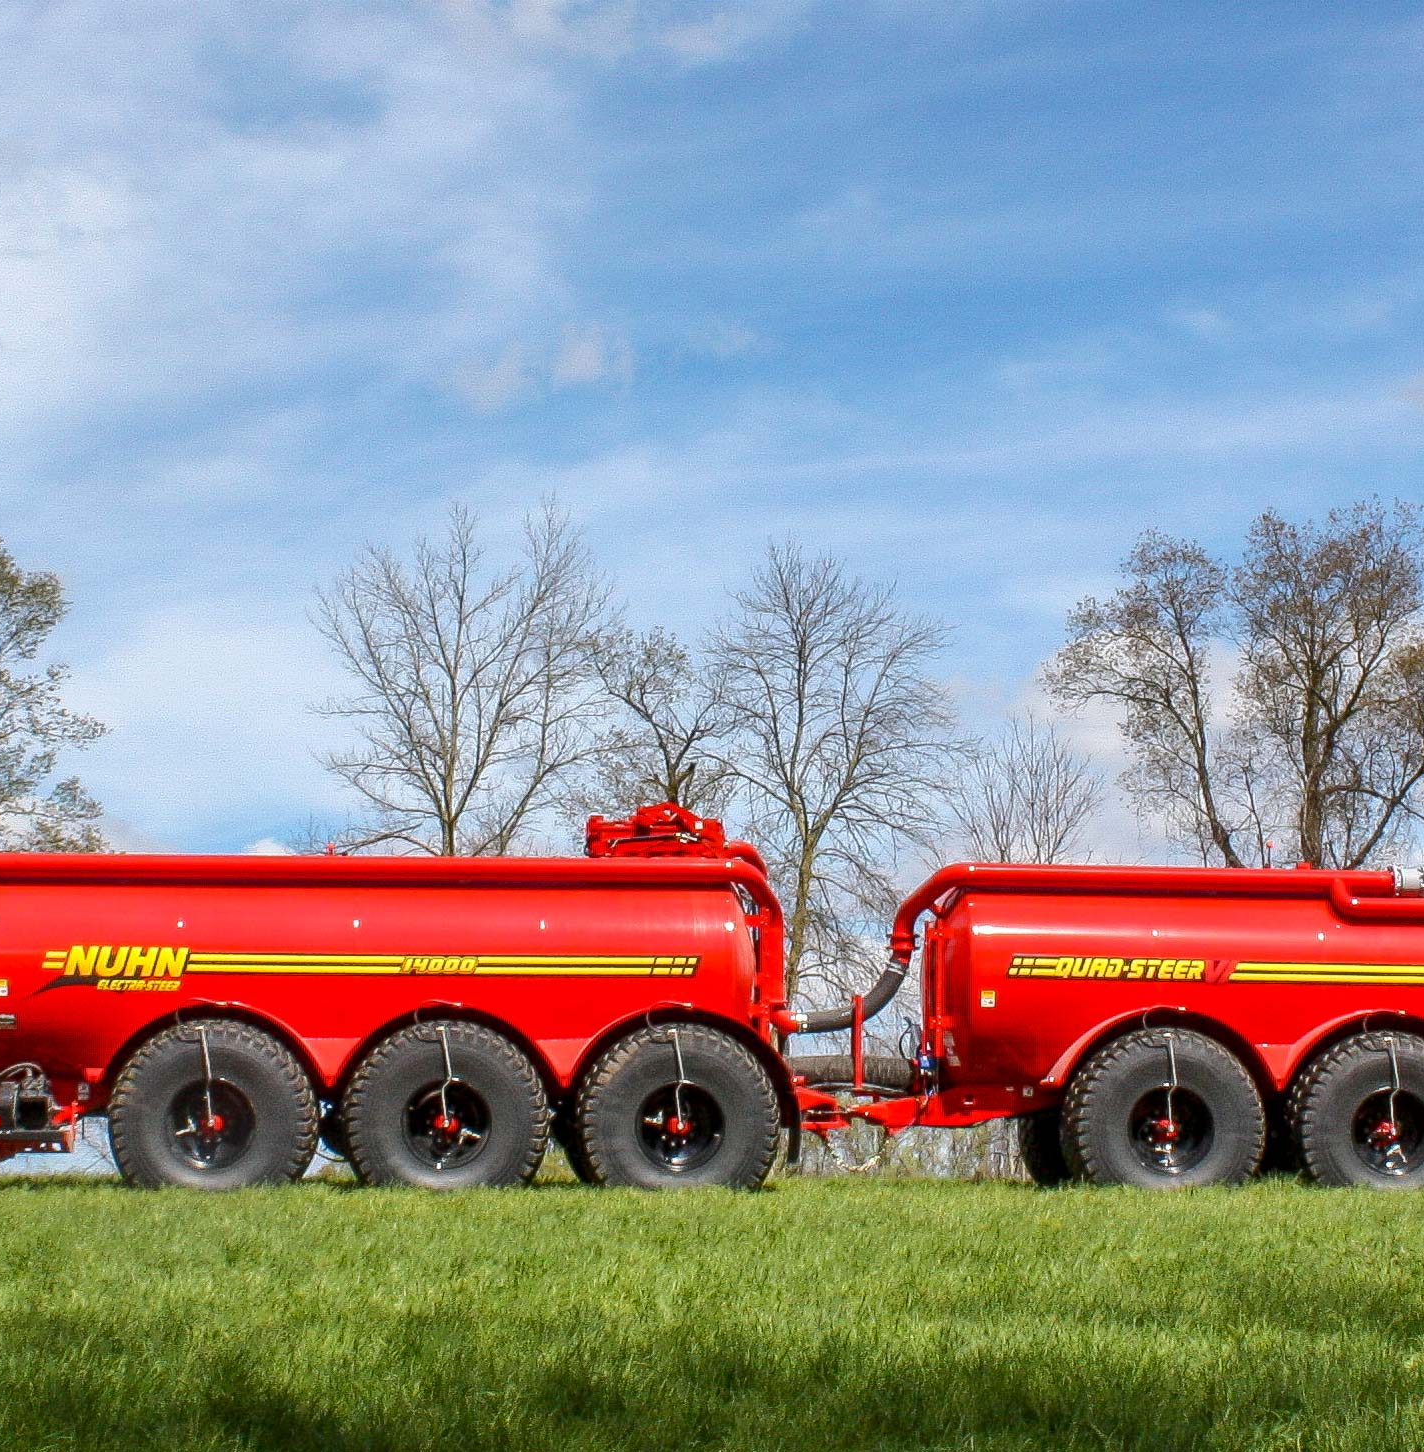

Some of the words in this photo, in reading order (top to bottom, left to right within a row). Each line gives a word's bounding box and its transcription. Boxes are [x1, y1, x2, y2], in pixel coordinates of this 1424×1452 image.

[64, 945, 189, 977] NUHN
[402, 957, 477, 973] 14000
[1055, 957, 1205, 980] QUAD-STEER
